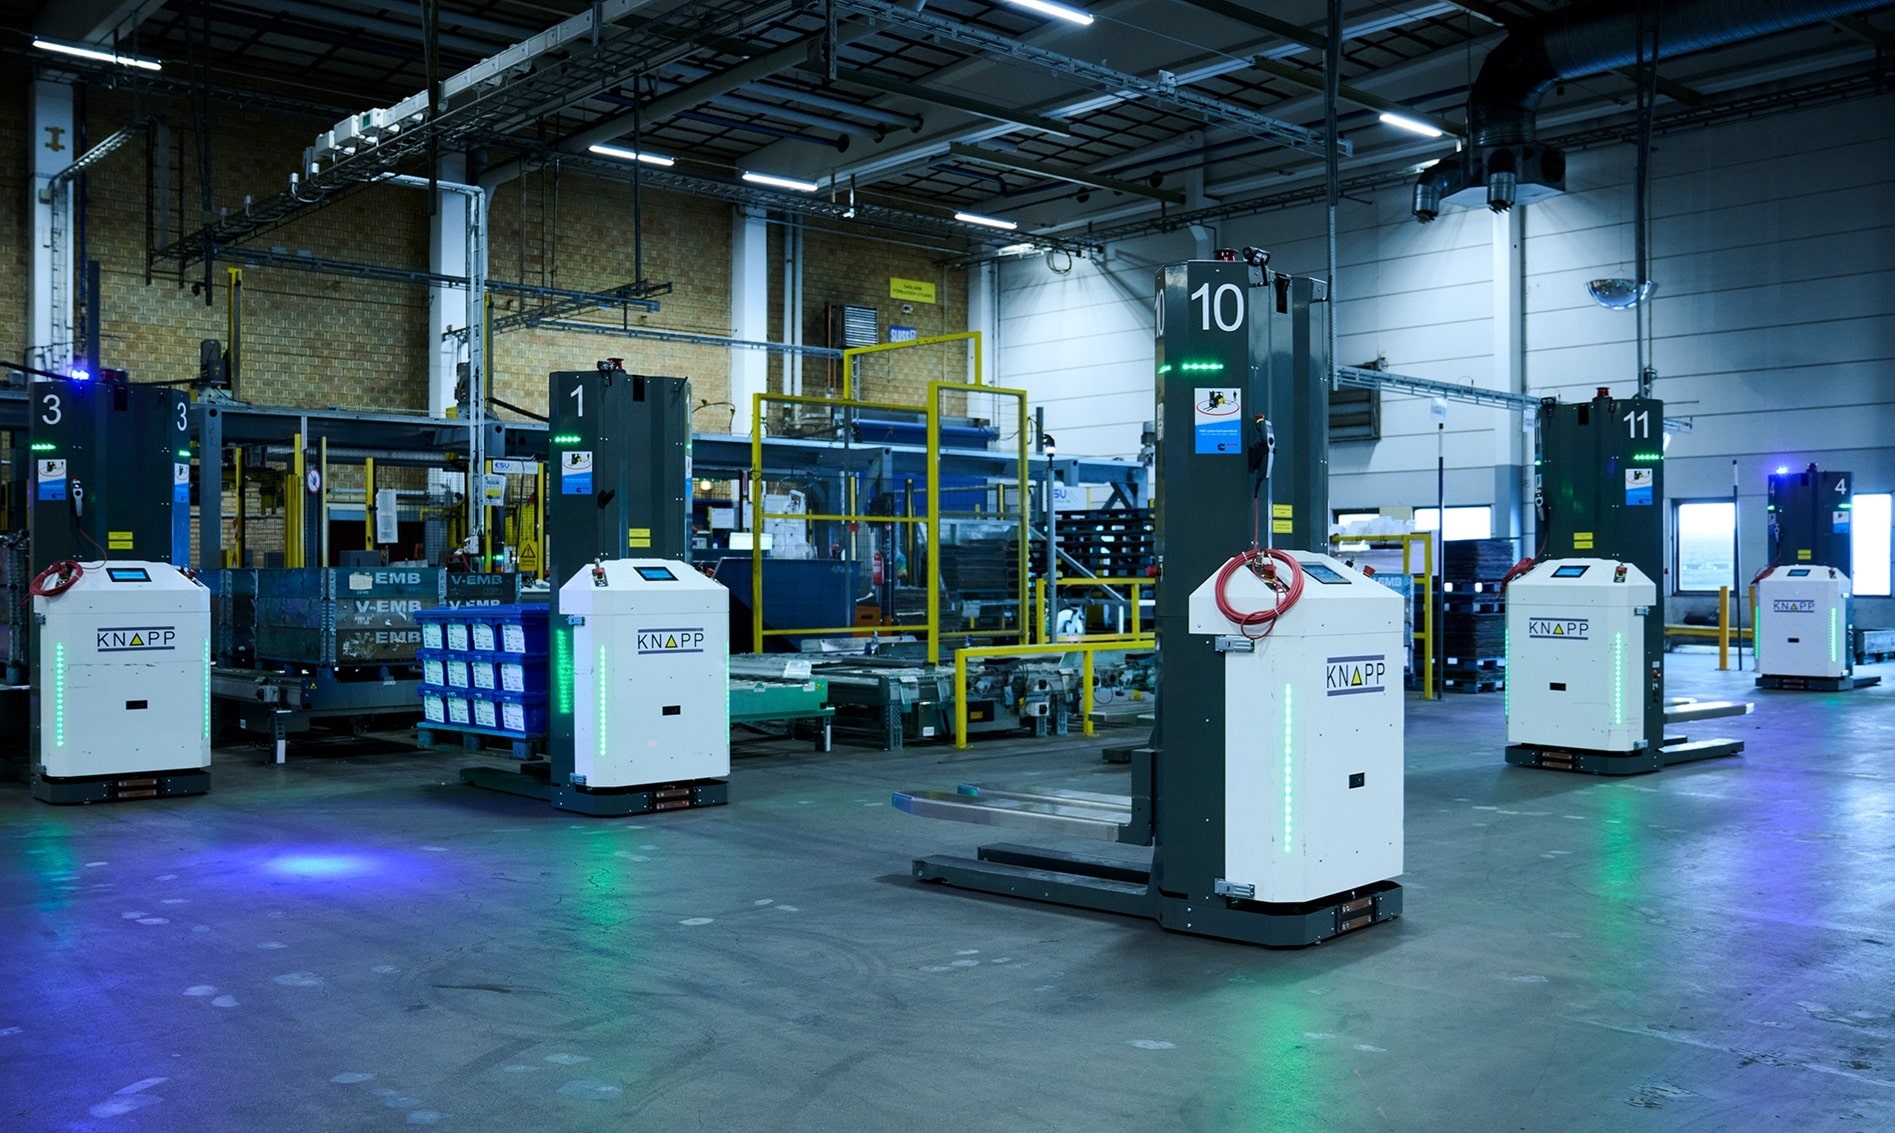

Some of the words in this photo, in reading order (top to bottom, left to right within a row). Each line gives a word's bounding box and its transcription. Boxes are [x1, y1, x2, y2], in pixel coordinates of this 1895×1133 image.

[1154, 288, 1166, 338] 10
[1191, 282, 1245, 332] 10
[570, 384, 583, 417] 1
[42, 394, 62, 425] 3
[176, 402, 188, 431] 3
[1623, 410, 1649, 438] 11
[1053, 489, 1067, 499] SU
[1769, 481, 1775, 496] 4
[1834, 478, 1847, 495] 4
[355, 600, 422, 613] V-EMB
[1773, 602, 1815, 610] KNAPP
[1529, 621, 1589, 635] KNAPP
[97, 631, 175, 647] KNAPP
[637, 633, 704, 649] KNAPP
[1326, 662, 1385, 688] KNAPP
